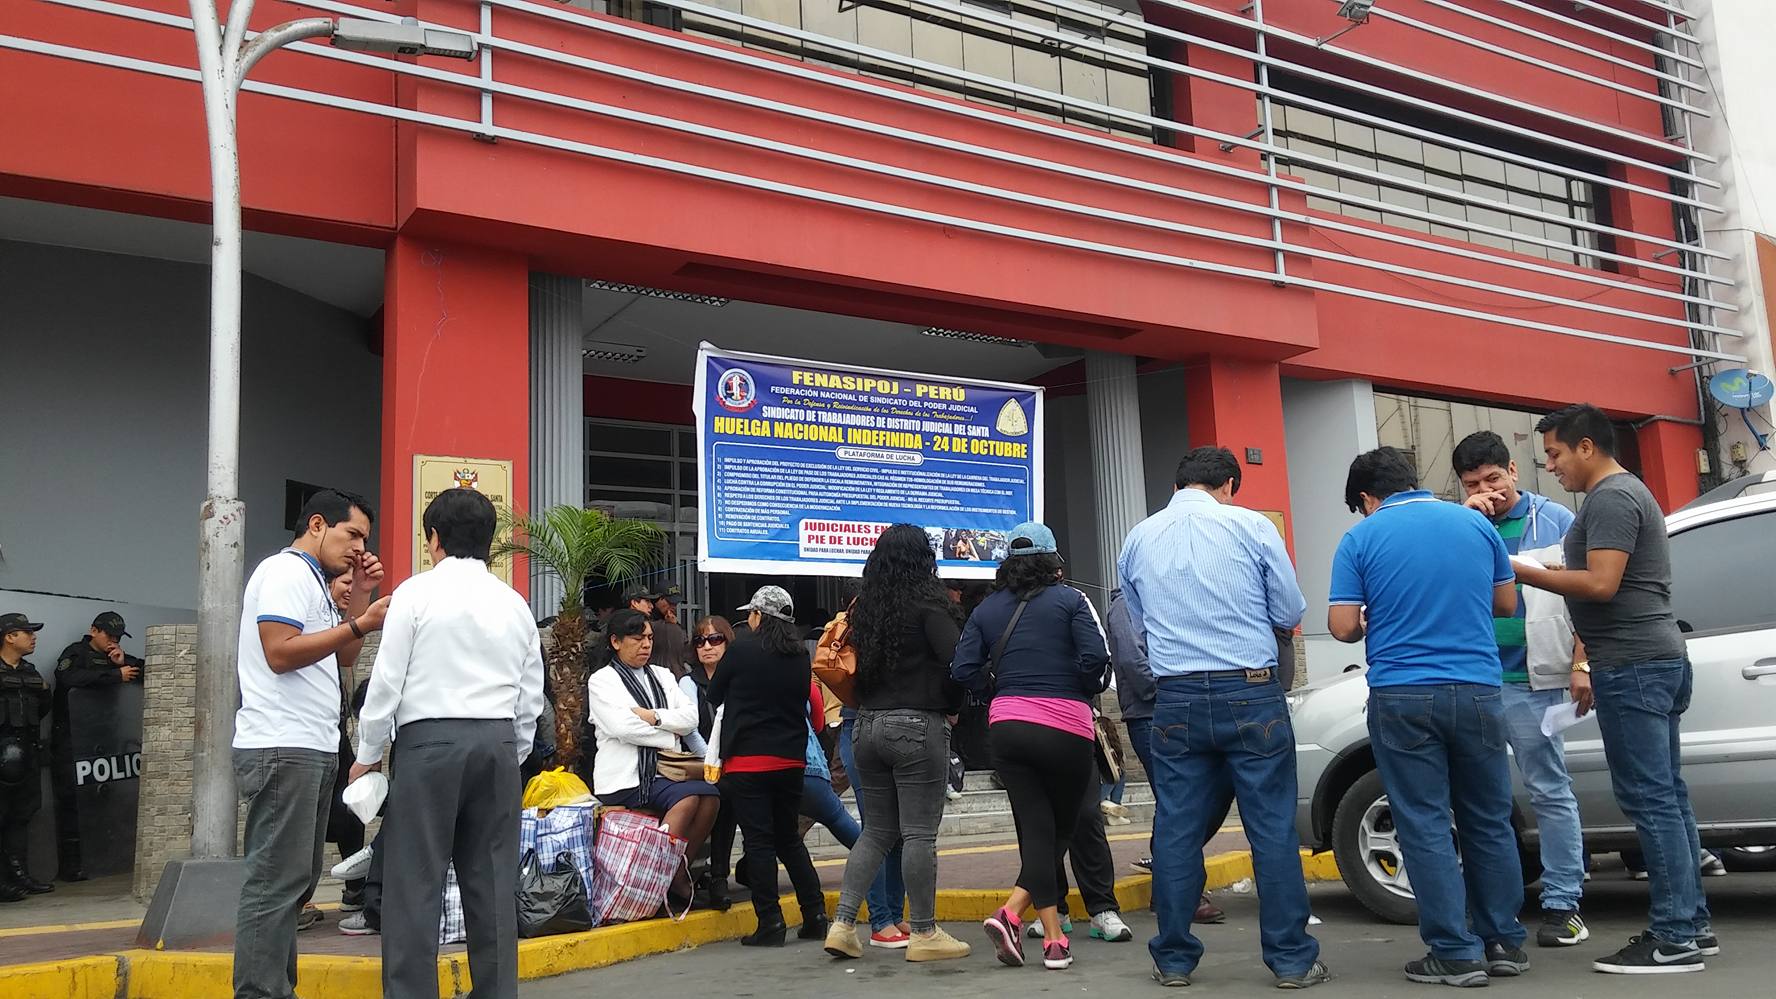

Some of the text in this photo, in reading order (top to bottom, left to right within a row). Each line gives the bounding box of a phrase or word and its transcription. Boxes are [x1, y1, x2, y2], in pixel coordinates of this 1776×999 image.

[770, 386, 818, 398] FEDERACIÓN
[820, 390, 857, 401] NACIONAL
[870, 396, 907, 406] SINDICATO
[948, 404, 978, 413] JUDICIAL
[792, 371, 898, 394] FENASIPOJ
[916, 384, 966, 401] PERÚ
[762, 406, 804, 421] SINDICATO
[806, 410, 815, 422] DE
[817, 411, 875, 427] TRABAJADORES
[876, 416, 885, 427] DE
[887, 418, 921, 431] DISTRITO
[922, 422, 952, 434] JUDICIAL
[954, 424, 966, 436] DEL
[968, 425, 989, 437] SANTA
[714, 416, 770, 437] HUELGA
[774, 422, 844, 444] NACIONAL
[848, 427, 922, 449] INDEFINIDA
[933, 436, 949, 452] 24
[952, 438, 967, 453] DE
[971, 439, 1028, 458] OCTUBRE
[844, 450, 884, 460] PLATAFORMA
[804, 522, 870, 534] JUDICIALES
[808, 534, 877, 546] PIE DE LUCH
